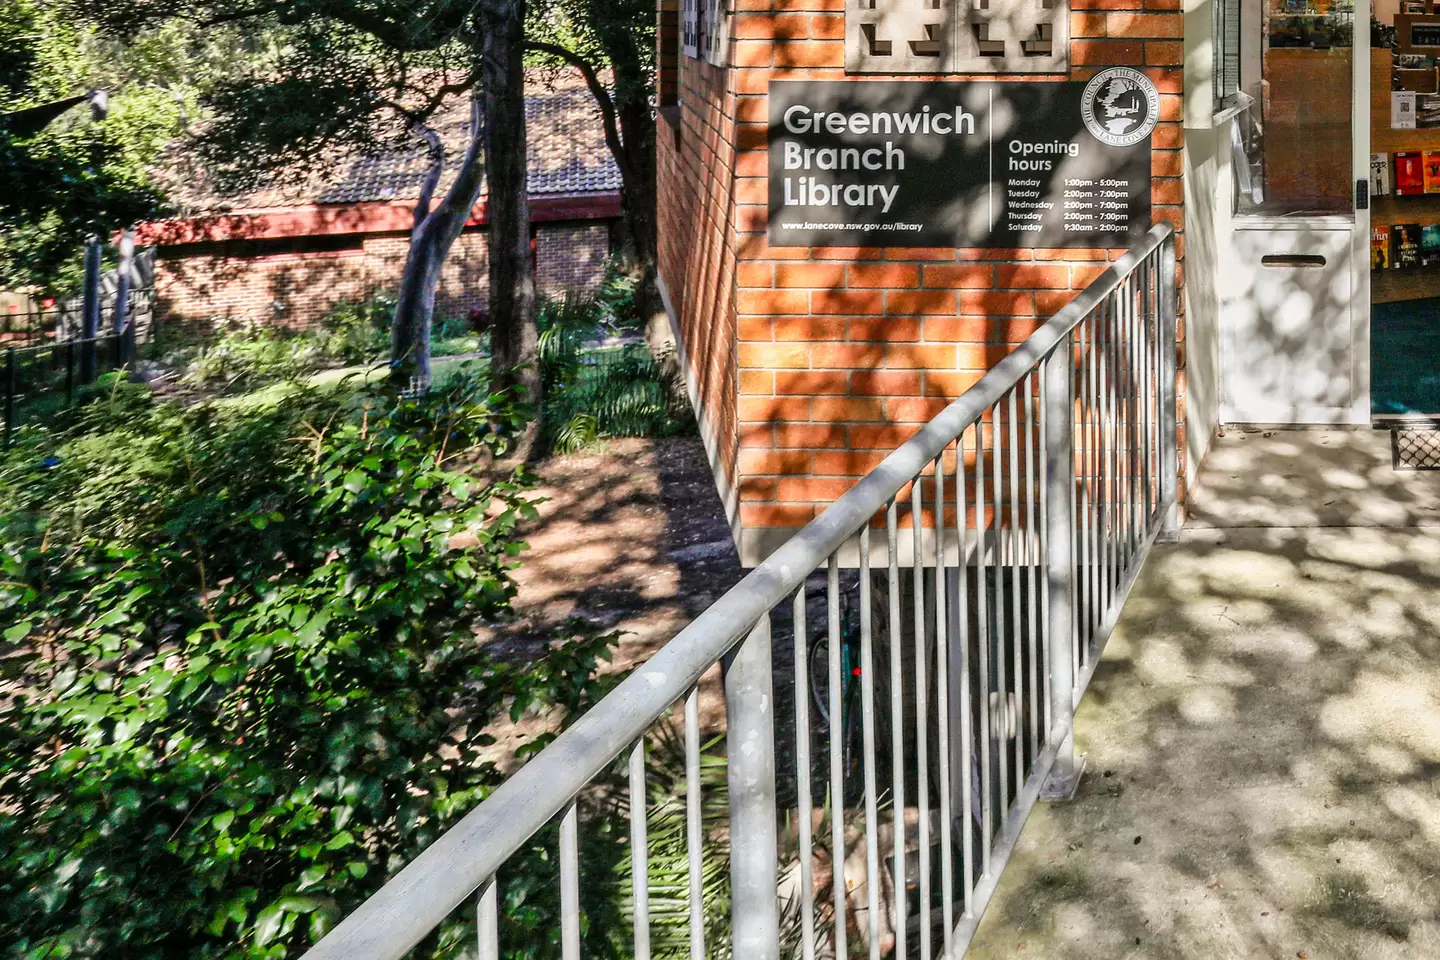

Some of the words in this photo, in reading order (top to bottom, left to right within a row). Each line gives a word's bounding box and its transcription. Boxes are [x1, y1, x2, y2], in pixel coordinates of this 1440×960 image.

[783, 105, 975, 135] Greenwich
[1008, 139, 1080, 157] Opening
[784, 141, 905, 170] Branch
[1008, 157, 1052, 171] hours
[1008, 179, 1041, 187] Monday
[1064, 179, 1092, 187] 1:00pm
[1100, 179, 1128, 187] 5:00pm
[784, 177, 899, 213] Library
[1008, 190, 1040, 198] Tuesday
[1064, 190, 1092, 198] 2:00pm
[1100, 190, 1128, 198] 7:00pm
[1008, 201, 1055, 209] Wednesday
[1064, 201, 1092, 209] 2:00pm
[1100, 201, 1128, 209] 7:00pm
[1008, 212, 1043, 220] Thursday
[1064, 212, 1092, 220] 2:00pm
[1100, 212, 1128, 220] 7:00pm
[782, 221, 923, 232] www.lanecove.nsw.gov.au/library
[1008, 223, 1043, 231] Saturday
[1100, 223, 1128, 231] 2:00pm
